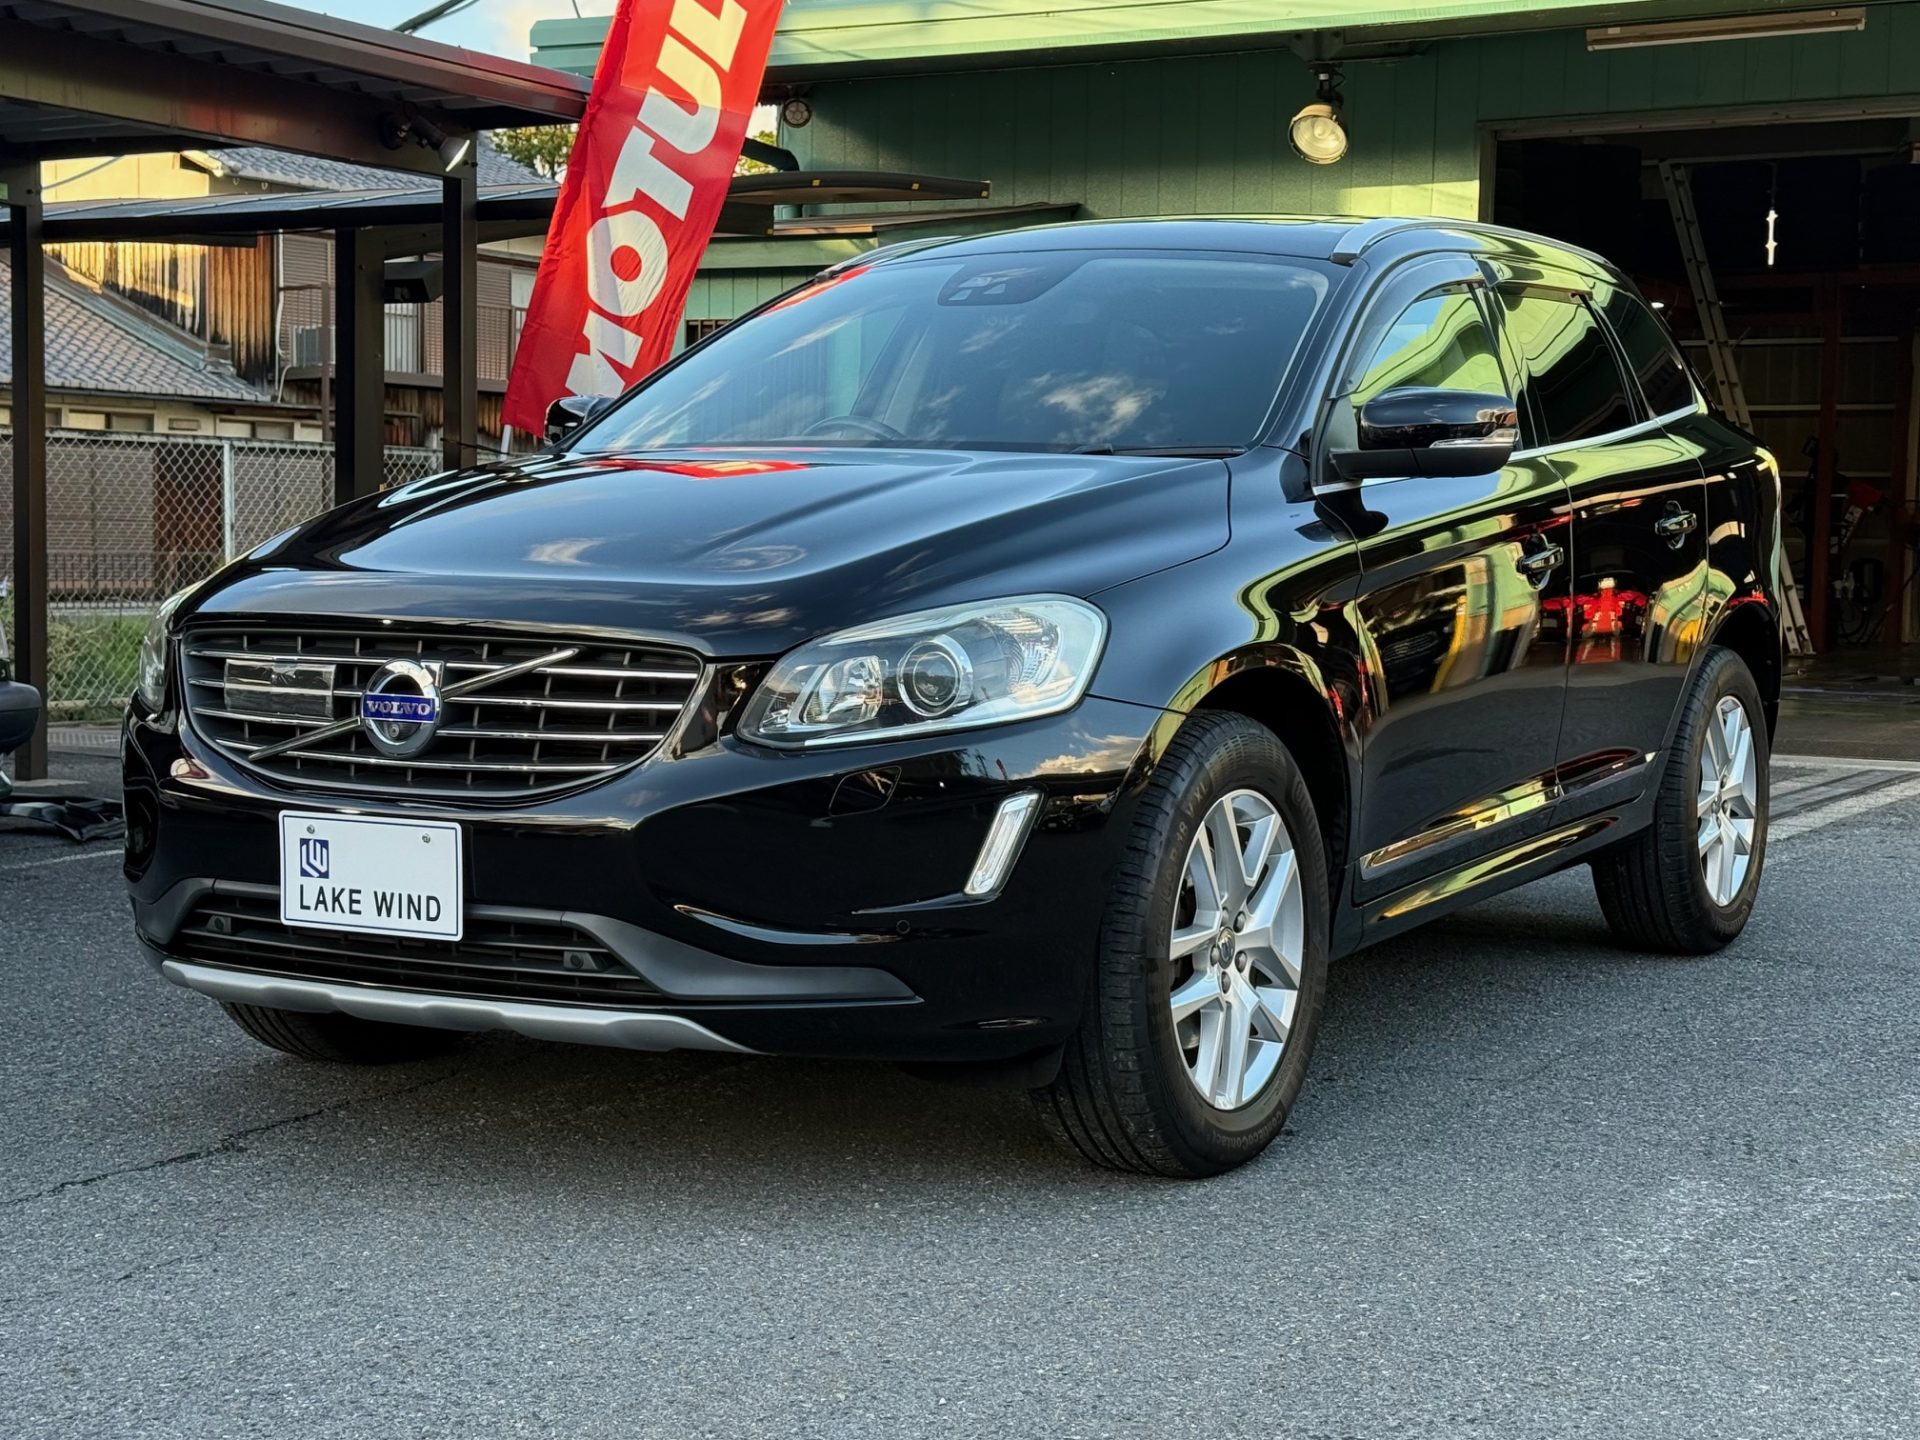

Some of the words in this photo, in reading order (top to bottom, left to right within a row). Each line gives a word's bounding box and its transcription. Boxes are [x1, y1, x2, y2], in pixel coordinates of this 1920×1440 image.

[566, 0, 747, 397] MOTUL
[366, 699, 432, 716] VOLVO
[299, 884, 362, 915] LAKE
[373, 890, 441, 922] WIND
